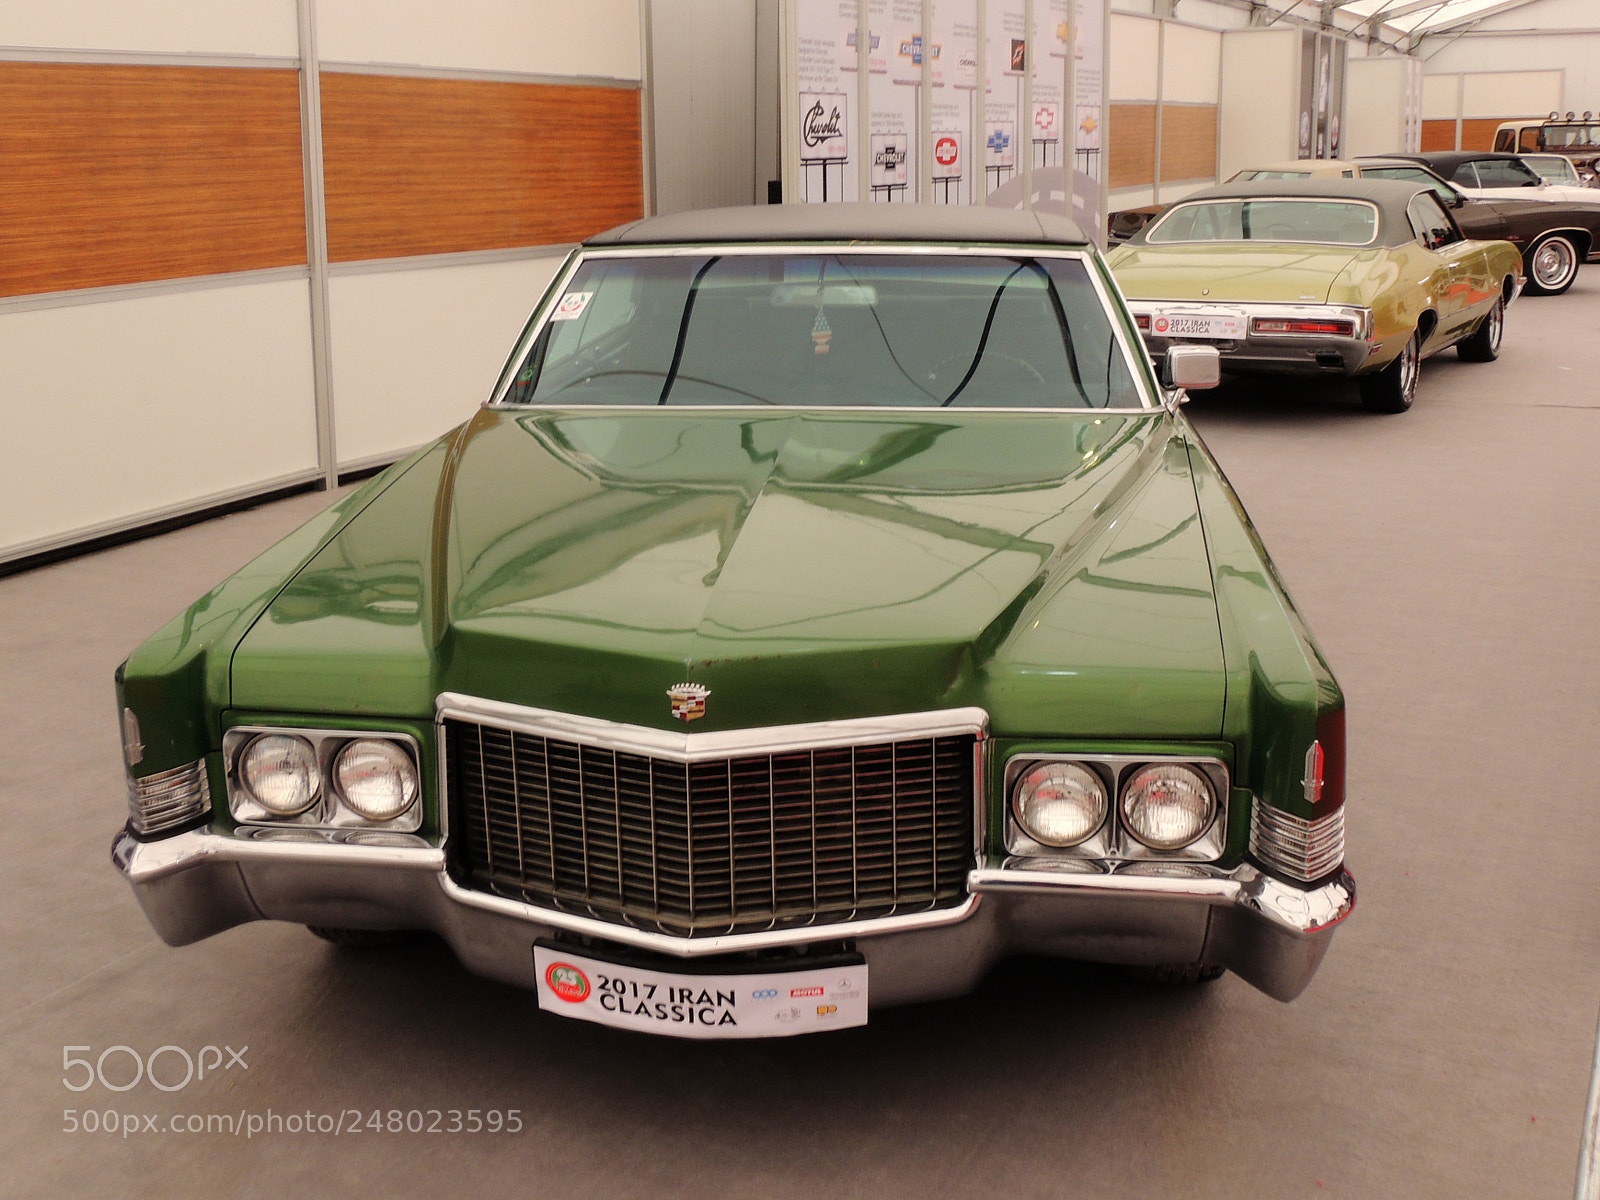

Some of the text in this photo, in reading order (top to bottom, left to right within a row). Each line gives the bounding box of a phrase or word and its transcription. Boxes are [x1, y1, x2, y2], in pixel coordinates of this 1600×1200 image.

[876, 152, 905, 164] CHEVROLET
[1170, 319, 1211, 327] 2017 IRAN
[597, 974, 658, 1000] 2017
[668, 986, 736, 1008] IRAN
[600, 993, 737, 1026] CLASSICA
